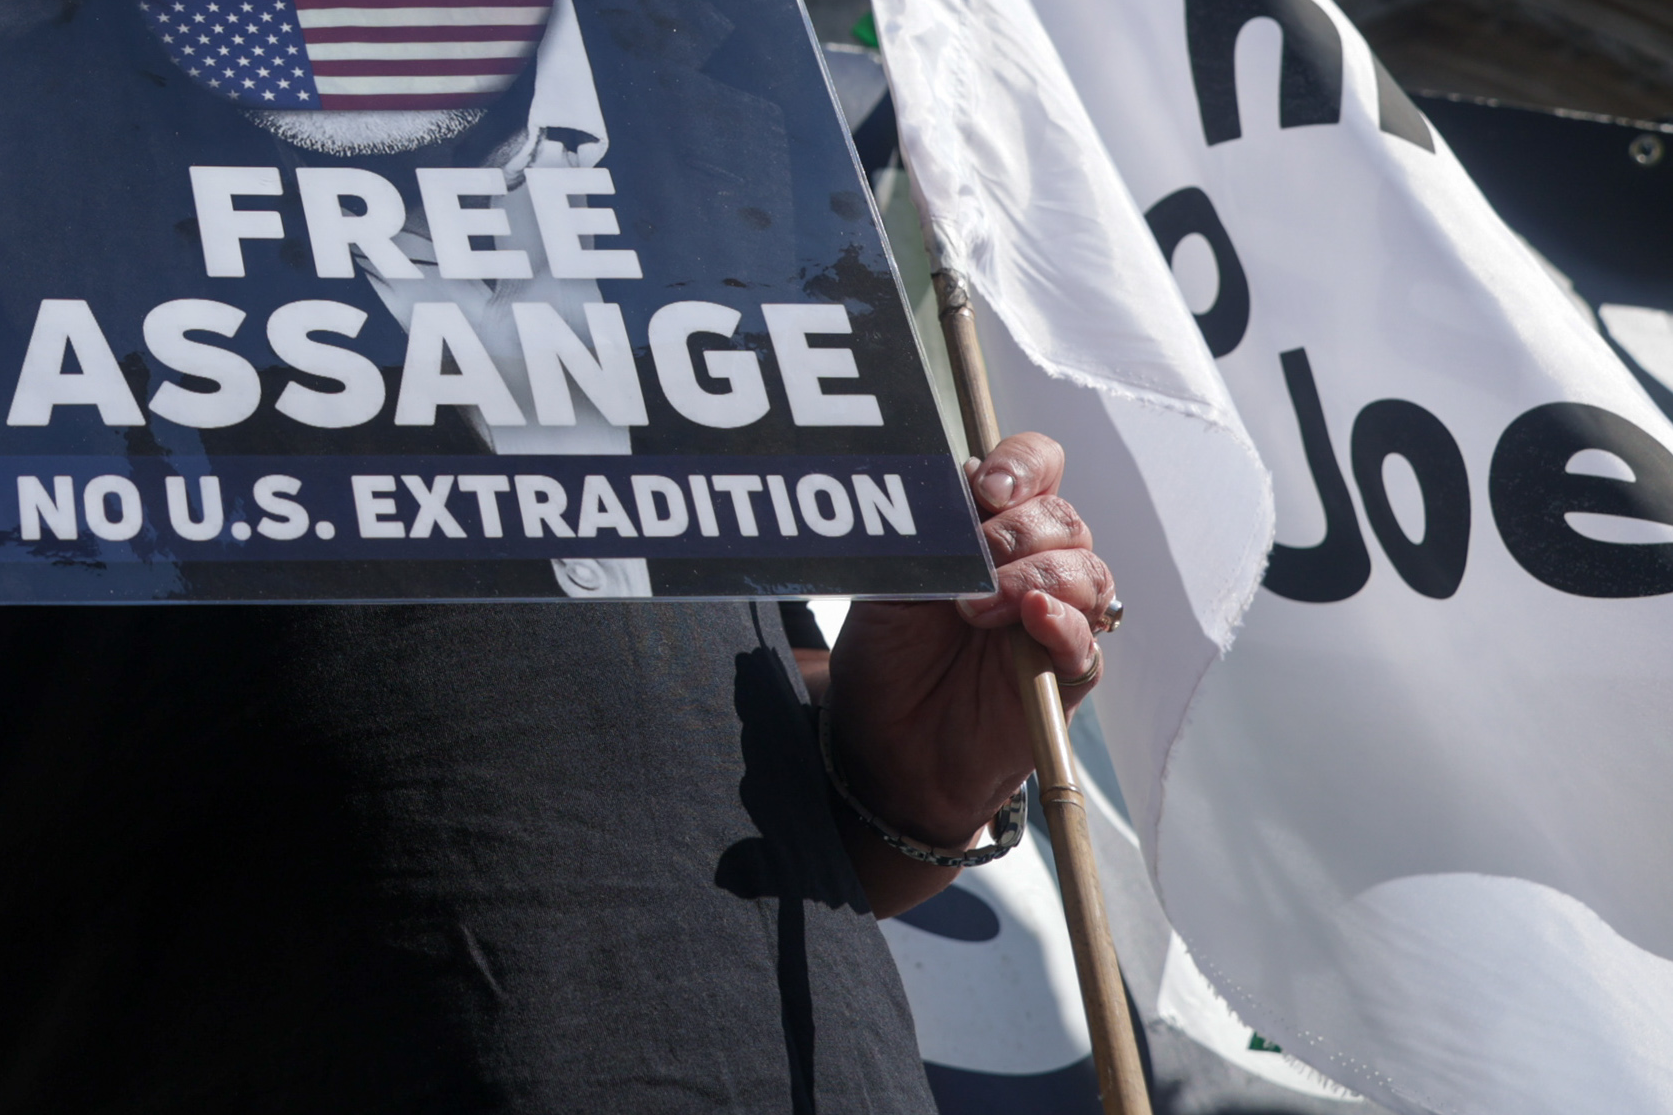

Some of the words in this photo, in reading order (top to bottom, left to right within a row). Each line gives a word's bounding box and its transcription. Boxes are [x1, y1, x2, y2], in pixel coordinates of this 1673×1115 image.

[189, 165, 643, 280] FREE
[6, 298, 885, 429] ASSANGE
[16, 474, 143, 542] NO
[165, 474, 336, 542] U.S.
[351, 473, 917, 540] EXTRADITION
[1259, 346, 1673, 604] Joe
